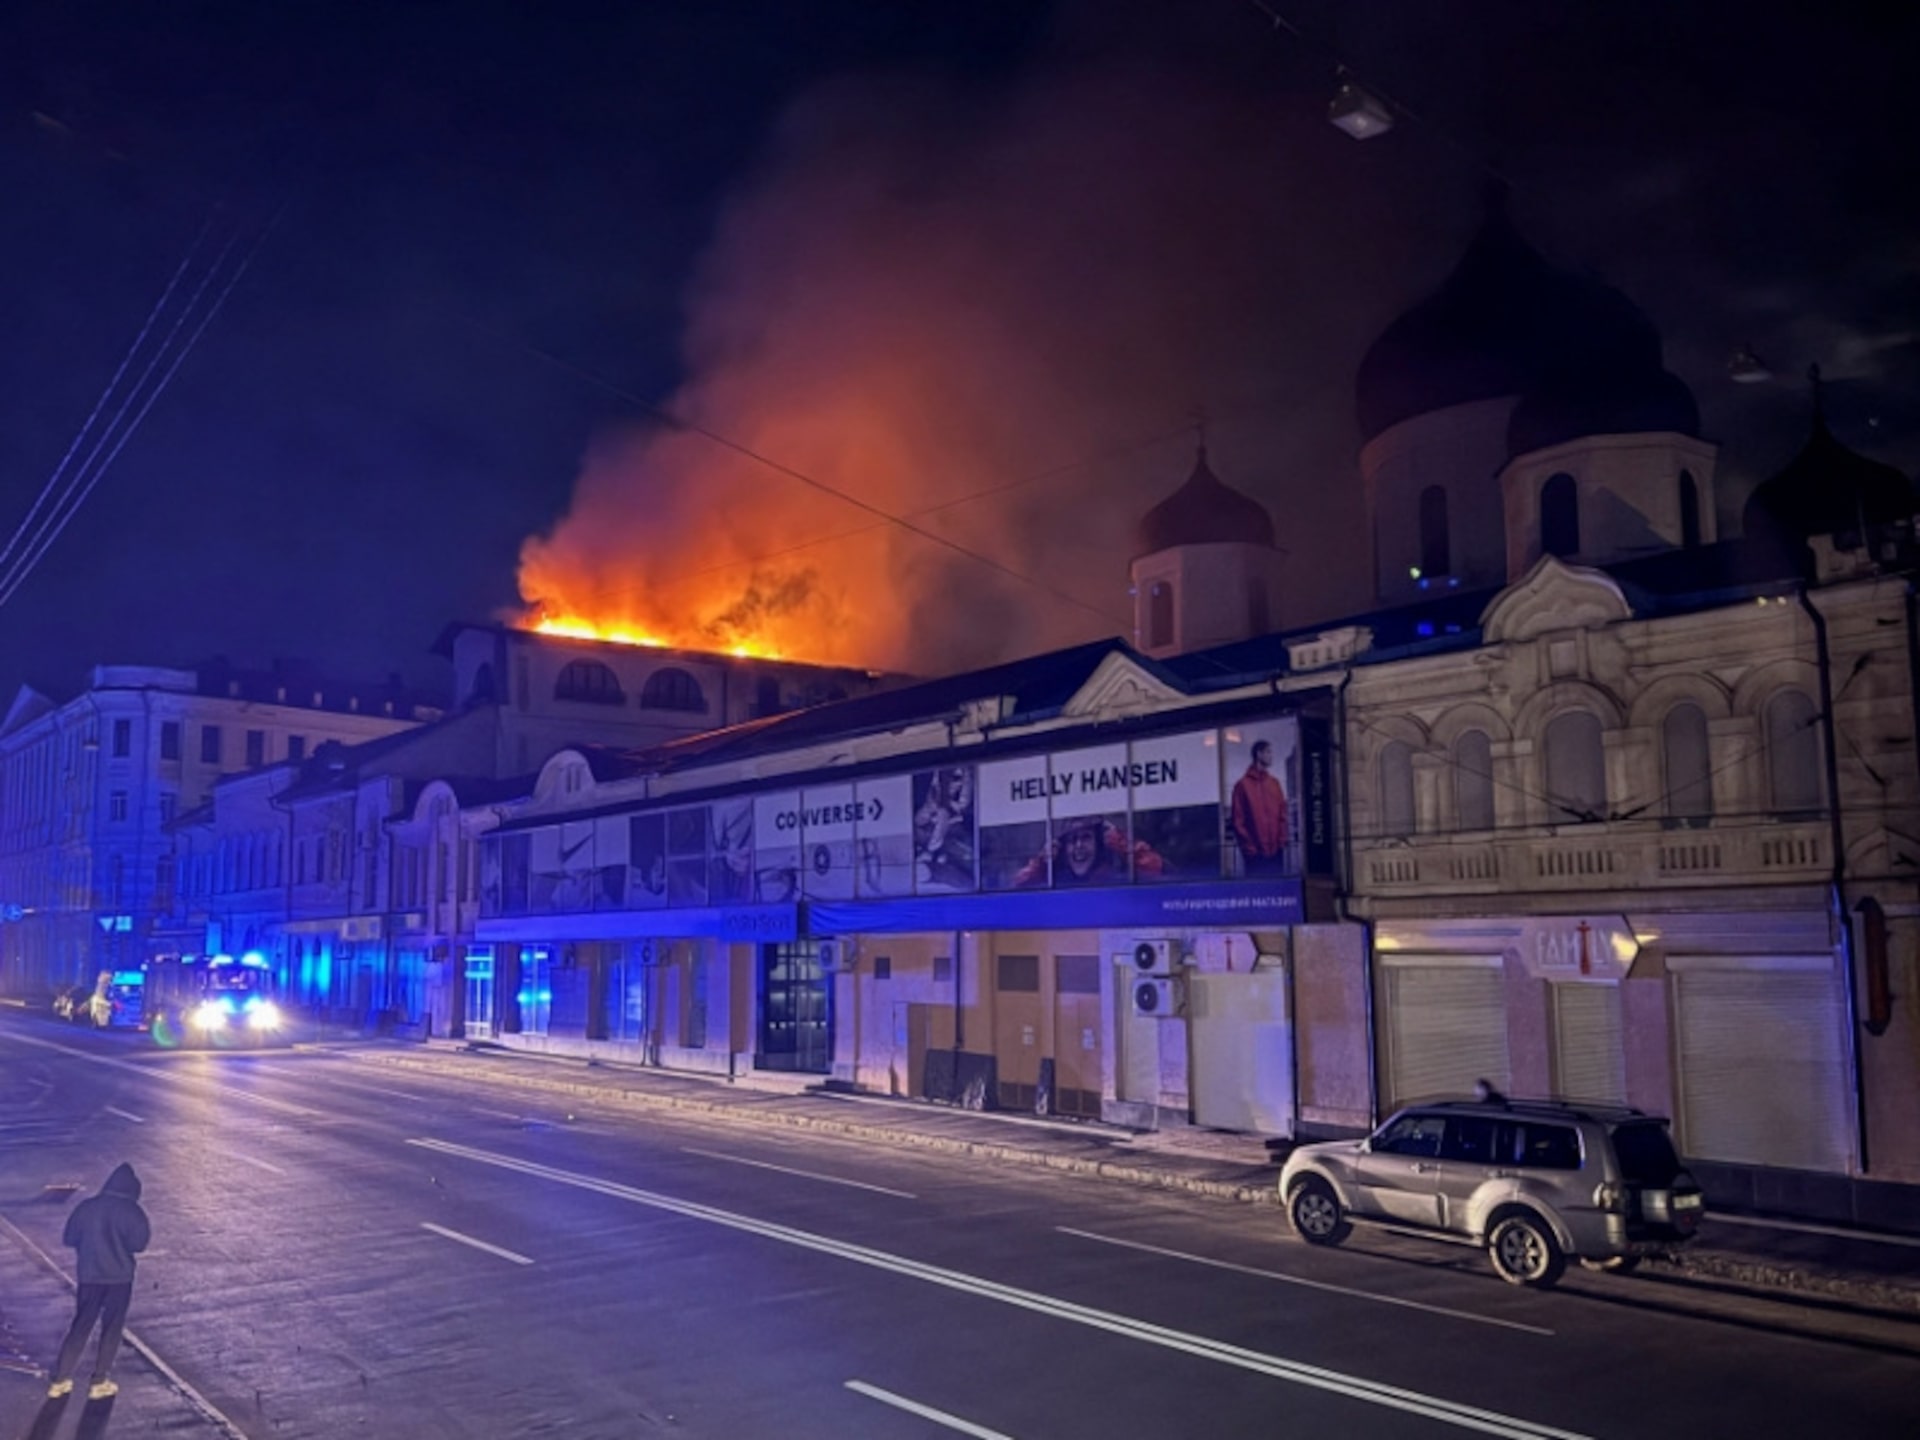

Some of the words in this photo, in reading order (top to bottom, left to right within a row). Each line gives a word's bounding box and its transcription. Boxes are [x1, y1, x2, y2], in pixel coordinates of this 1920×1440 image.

[1010, 772, 1074, 801] HELLY
[1081, 758, 1178, 793] HANSEN
[775, 802, 864, 830] CONVERSE
